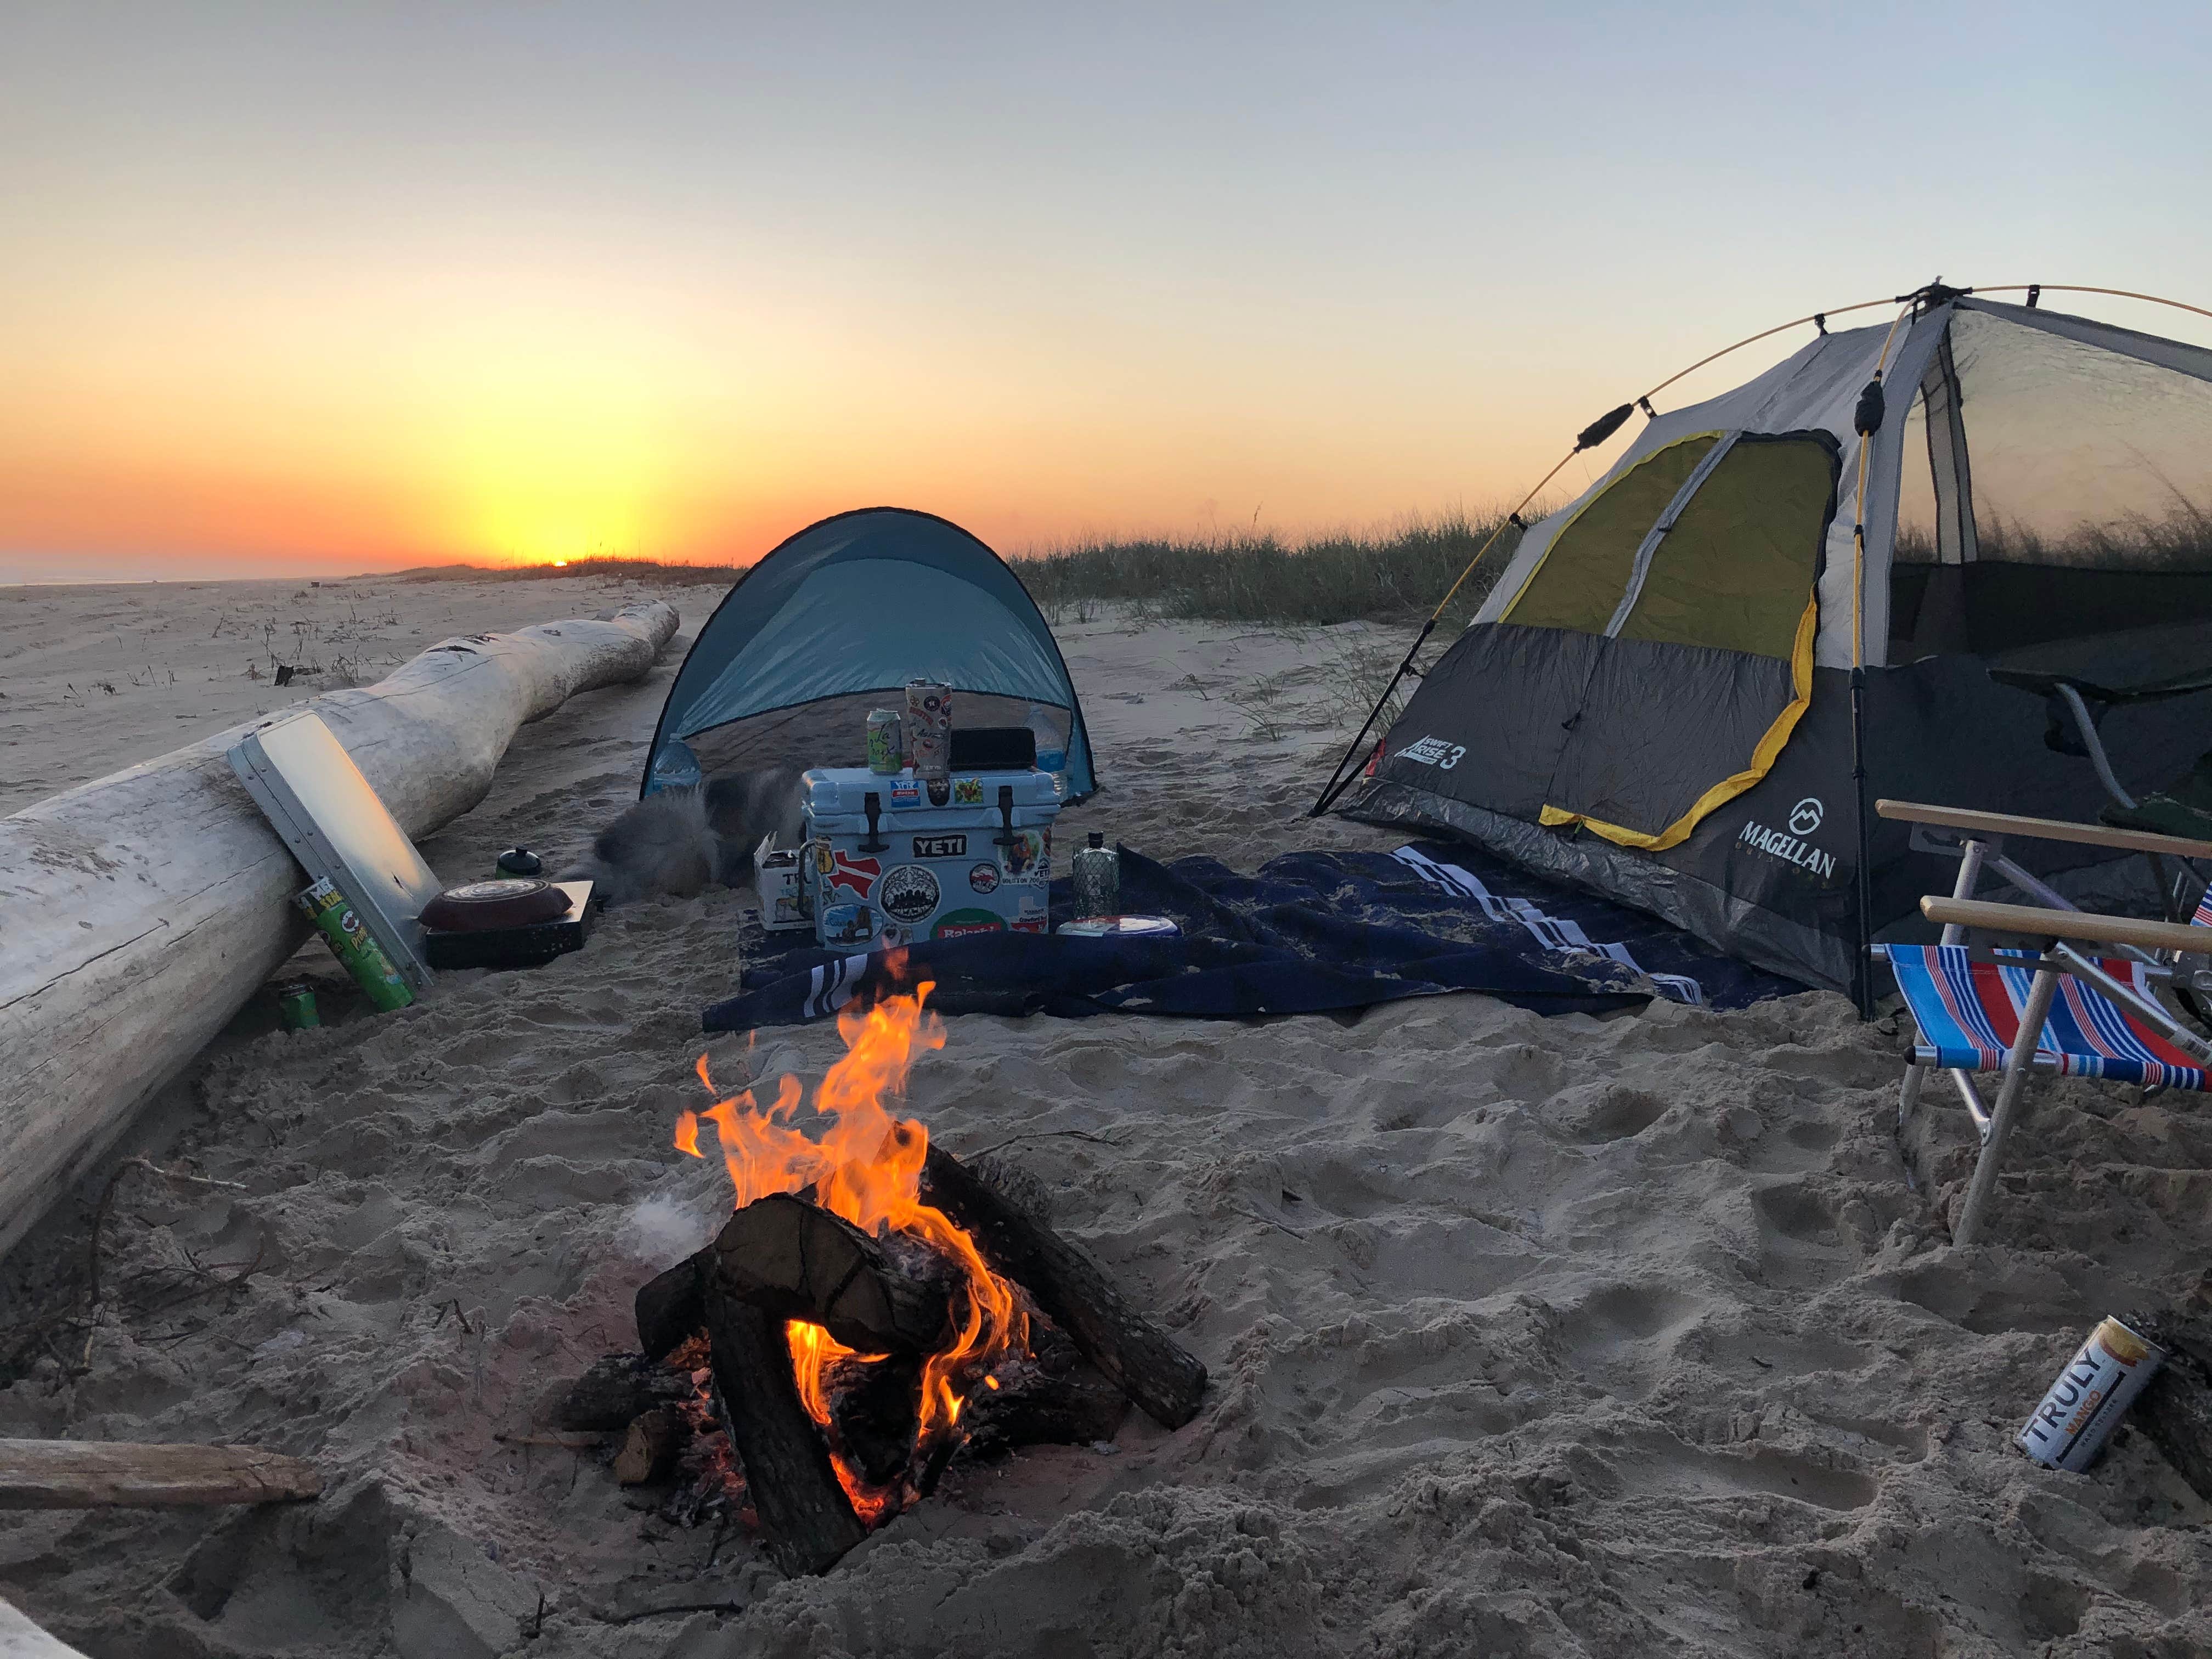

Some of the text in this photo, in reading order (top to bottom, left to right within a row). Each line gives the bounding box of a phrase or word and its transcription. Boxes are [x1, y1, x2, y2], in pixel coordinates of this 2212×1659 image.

[874, 724, 890, 744] La
[1424, 738, 1453, 749] SWIFT
[1415, 745, 1466, 769] RISE 3
[916, 839, 962, 854] YETI
[1739, 821, 1836, 879] MAGELLAN
[2023, 1347, 2101, 1443] TRULY
[2064, 1390, 2101, 1435] MANGO
